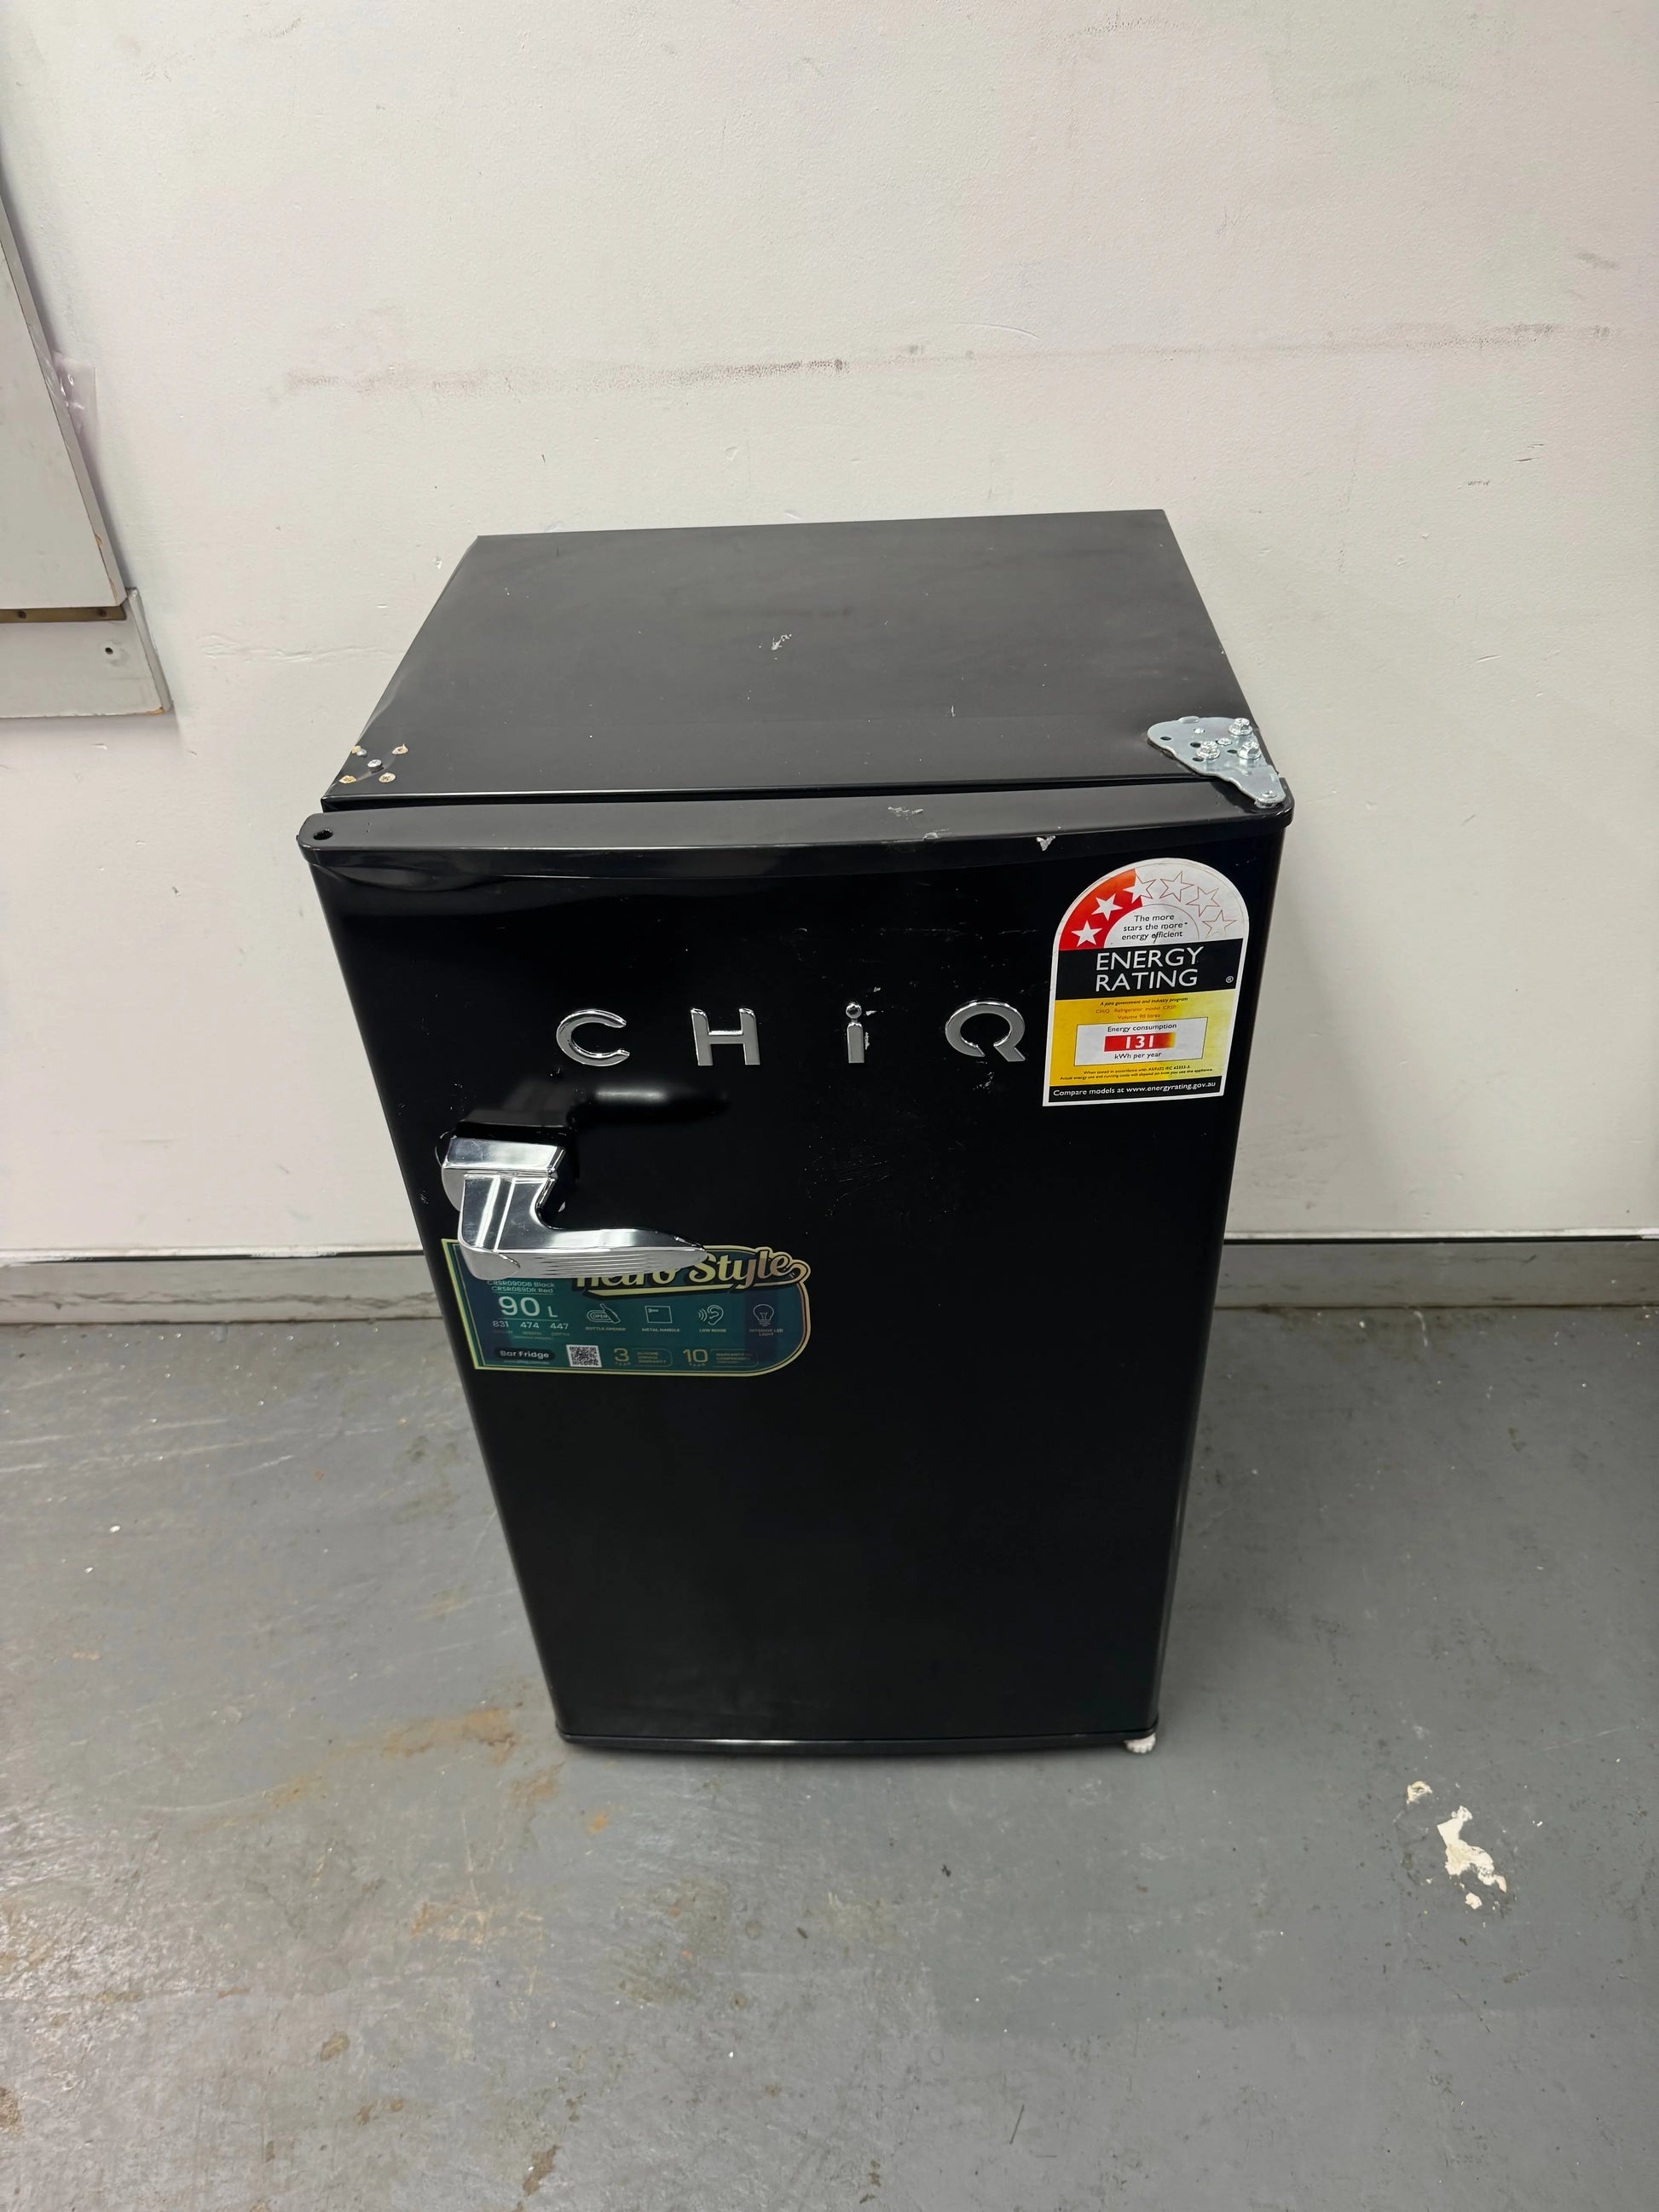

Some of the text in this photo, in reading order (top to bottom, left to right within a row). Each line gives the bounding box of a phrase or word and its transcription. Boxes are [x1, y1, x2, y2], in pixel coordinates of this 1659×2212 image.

[1121, 930, 1183, 942] energy efficient
[1095, 945, 1205, 972] ENERGY
[1095, 968, 1199, 993] RATING
[1132, 1023, 1177, 1031] consumption
[1125, 1034, 1155, 1049] 131
[1053, 1089, 1087, 1097] Compare
[1125, 1082, 1217, 1093] www.energyrating.gov.au
[688, 1250, 809, 1289] Style
[498, 1296, 558, 1318] 90 L
[550, 1322, 569, 1331] 447
[518, 1350, 550, 1360] Fridge
[614, 1348, 630, 1362] 3
[683, 1349, 708, 1363] 10
